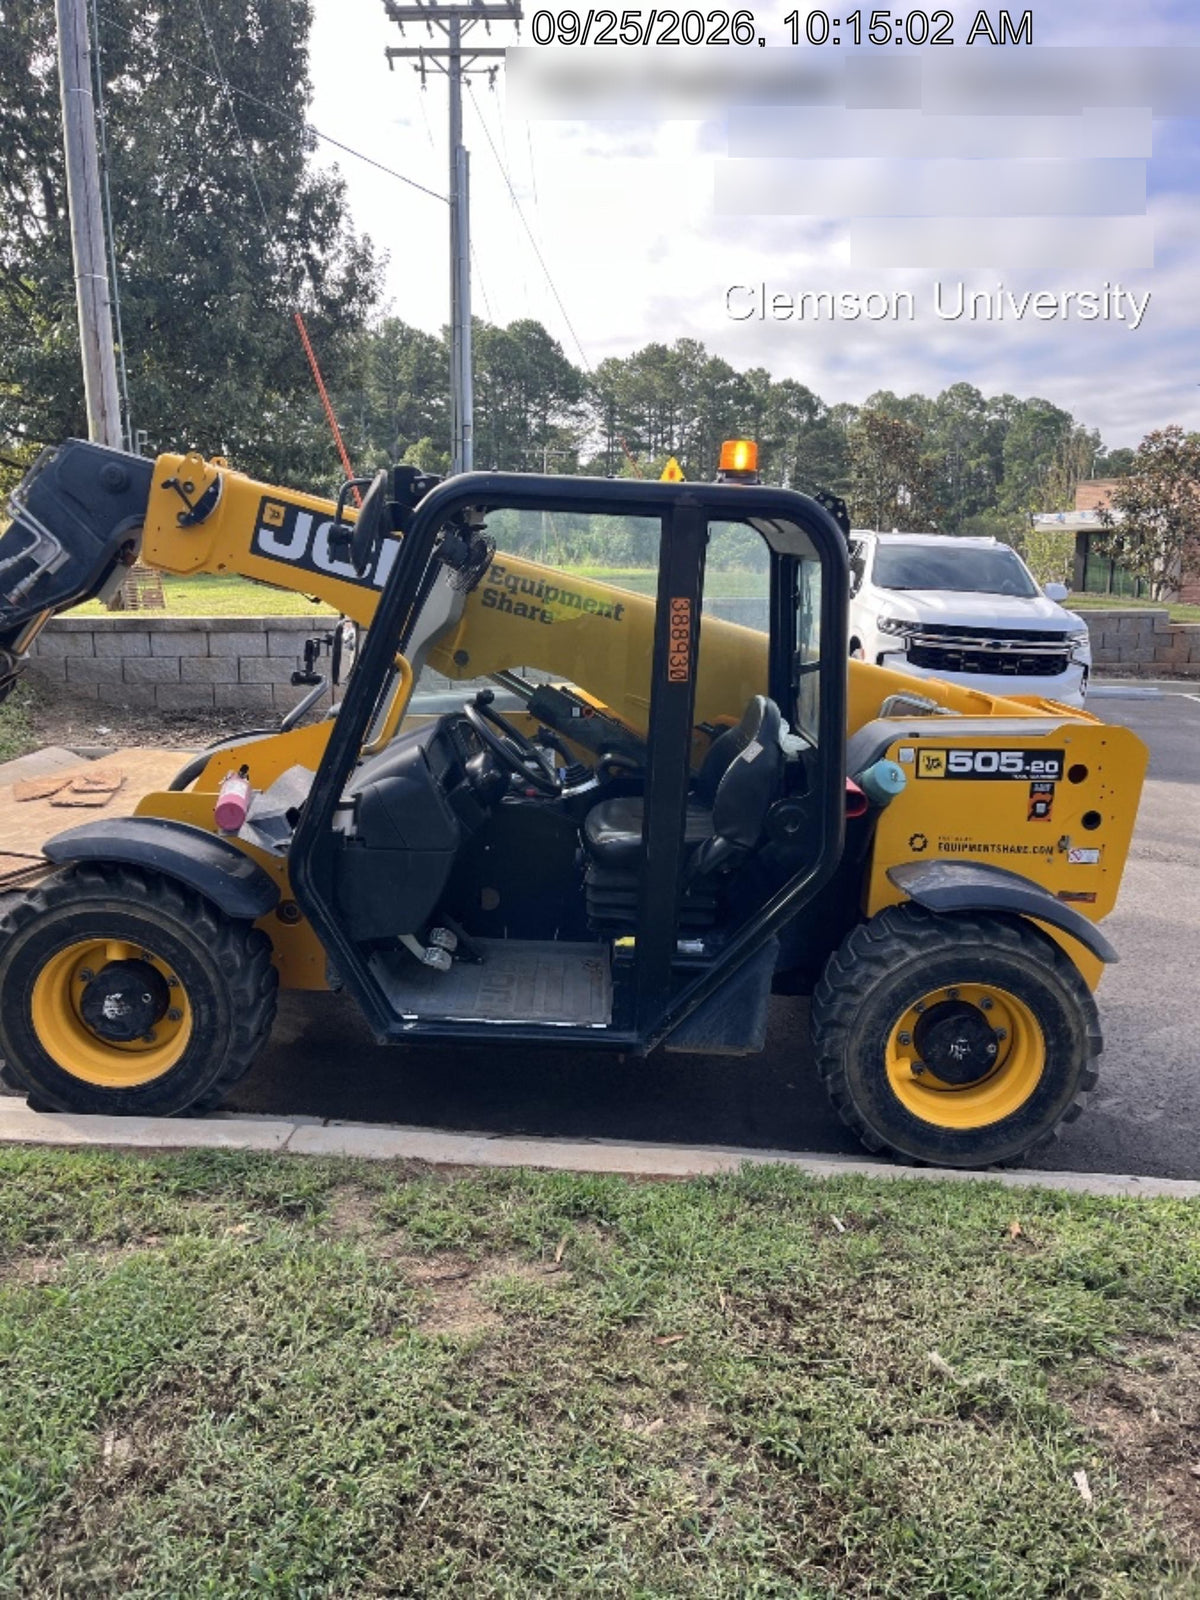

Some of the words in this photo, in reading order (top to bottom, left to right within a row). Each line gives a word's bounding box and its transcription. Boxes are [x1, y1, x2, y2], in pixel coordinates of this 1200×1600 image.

[481, 587, 554, 624] Share
[487, 565, 625, 622] Equipment
[670, 600, 689, 680] 388930
[938, 842, 1054, 855] EQUIPMENTSHARE.COM
